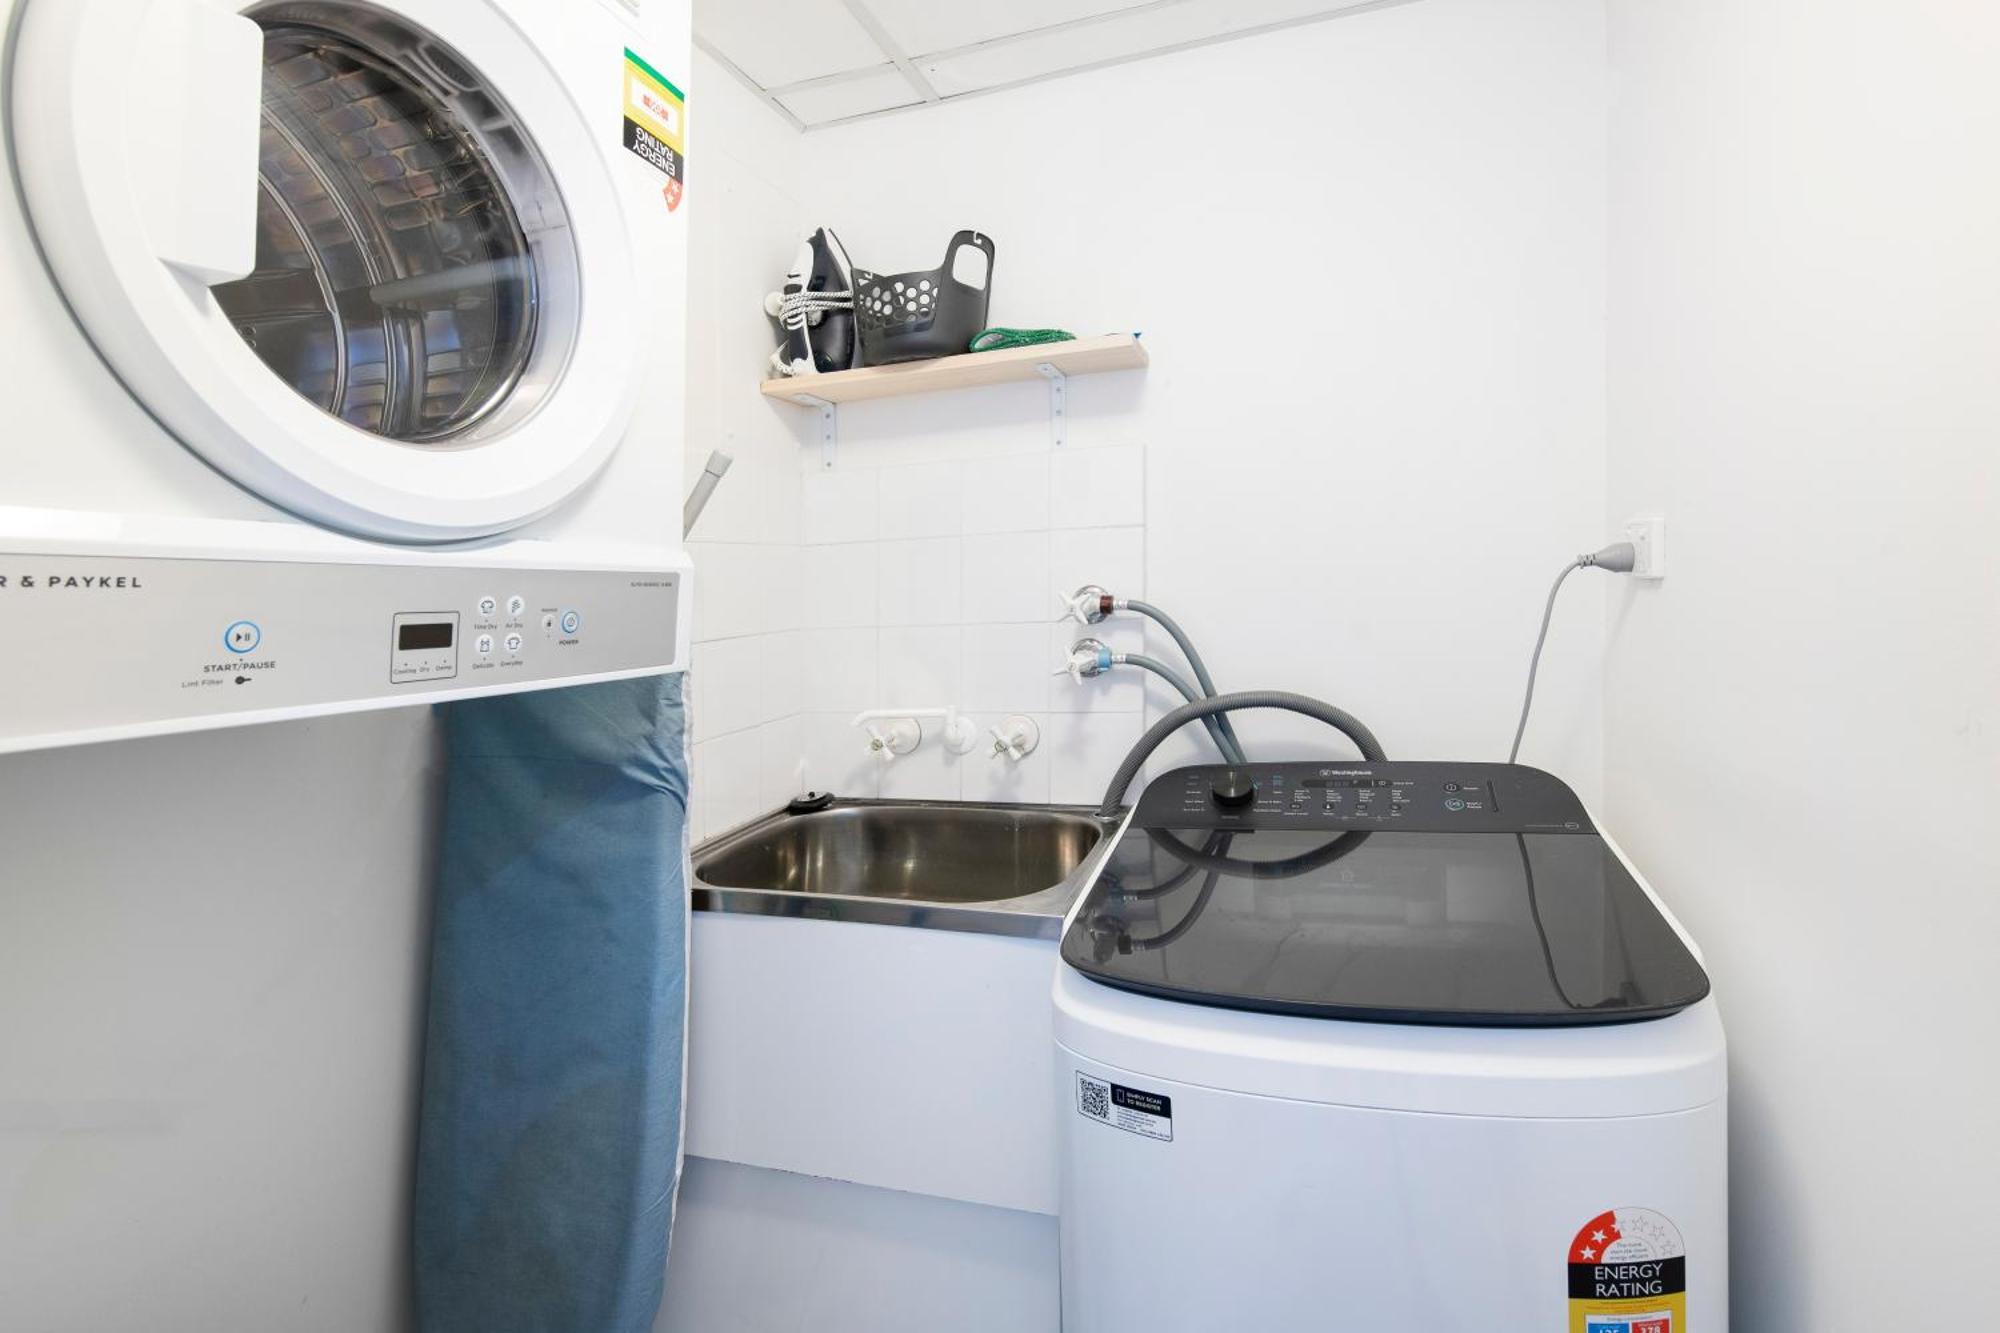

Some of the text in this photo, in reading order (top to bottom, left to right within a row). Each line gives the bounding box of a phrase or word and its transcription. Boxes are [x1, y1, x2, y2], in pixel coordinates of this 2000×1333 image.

[636, 127, 673, 162] RATING
[632, 140, 675, 177] ENERGY
[20, 575, 34, 588] &
[48, 576, 141, 588] PAYKEL
[203, 661, 276, 673] START/PAUSE
[1595, 1263, 1663, 1280] ENERGY
[1596, 1281, 1662, 1297] RATING
